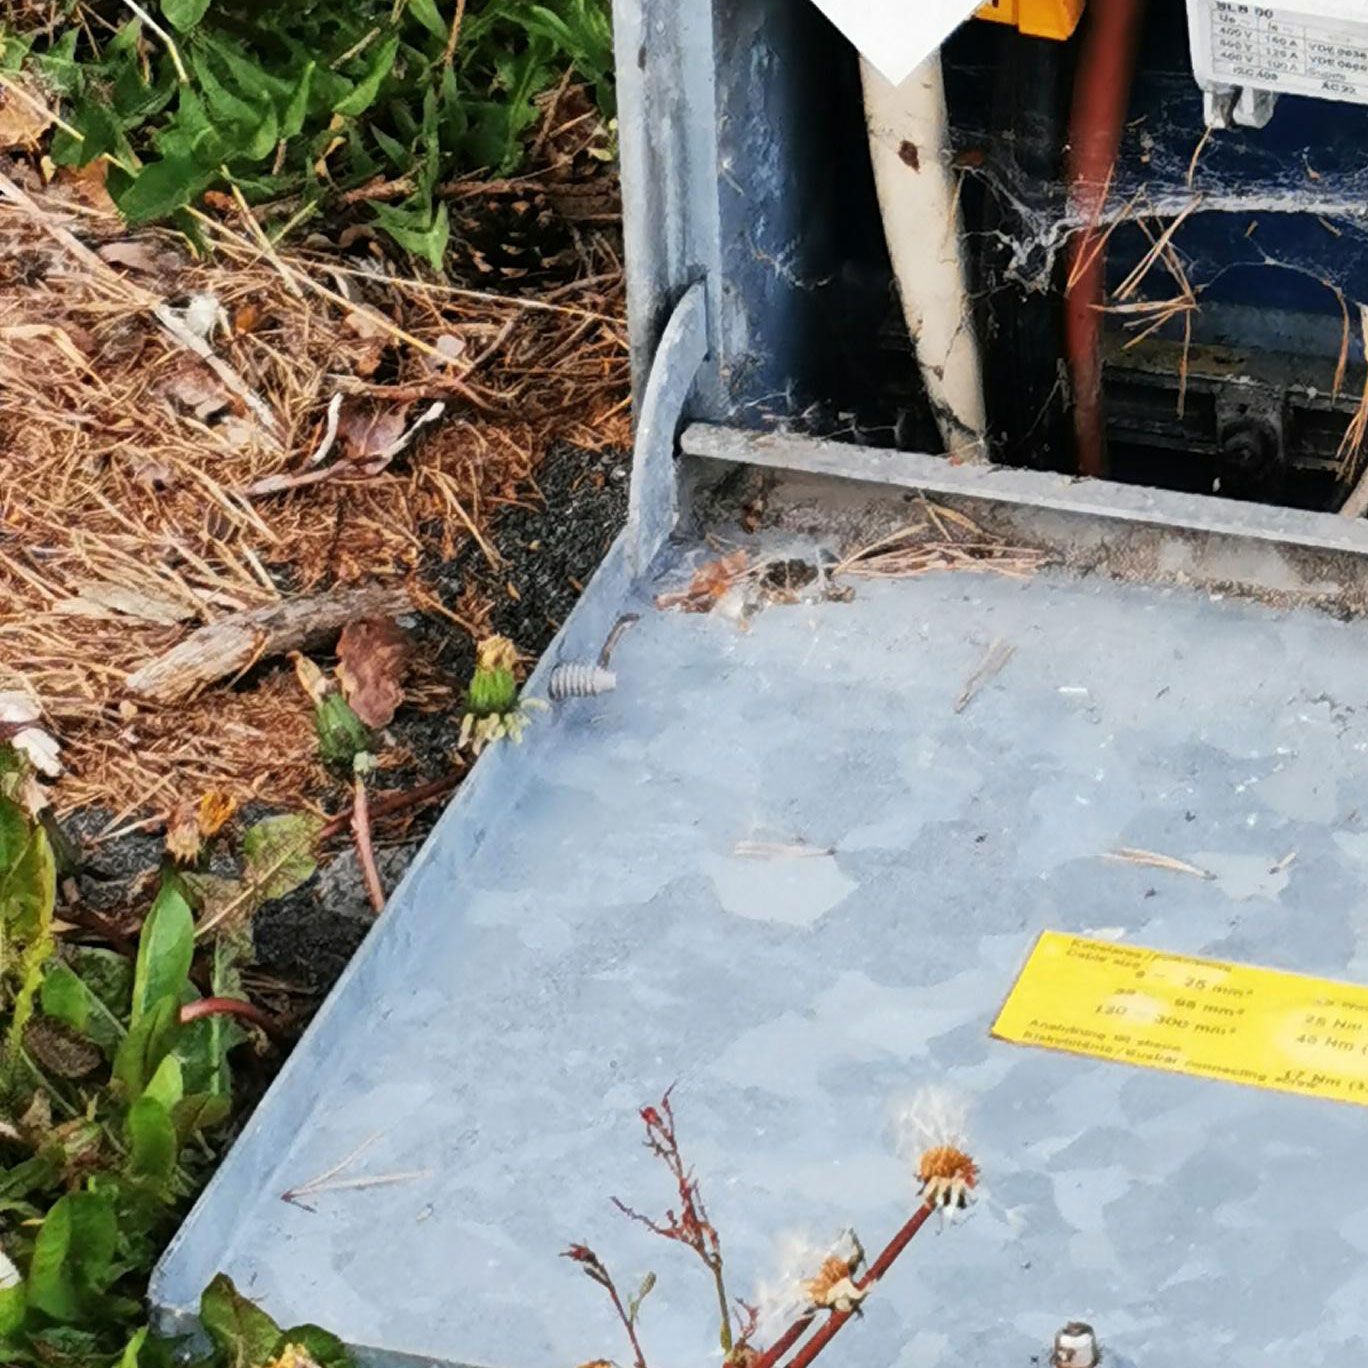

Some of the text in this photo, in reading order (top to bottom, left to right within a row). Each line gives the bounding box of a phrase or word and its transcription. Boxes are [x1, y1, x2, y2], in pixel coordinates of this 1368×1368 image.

[1321, 82, 1339, 92] AC
[1333, 1018, 1362, 1031] Nm
[1325, 1037, 1354, 1051] Nm
